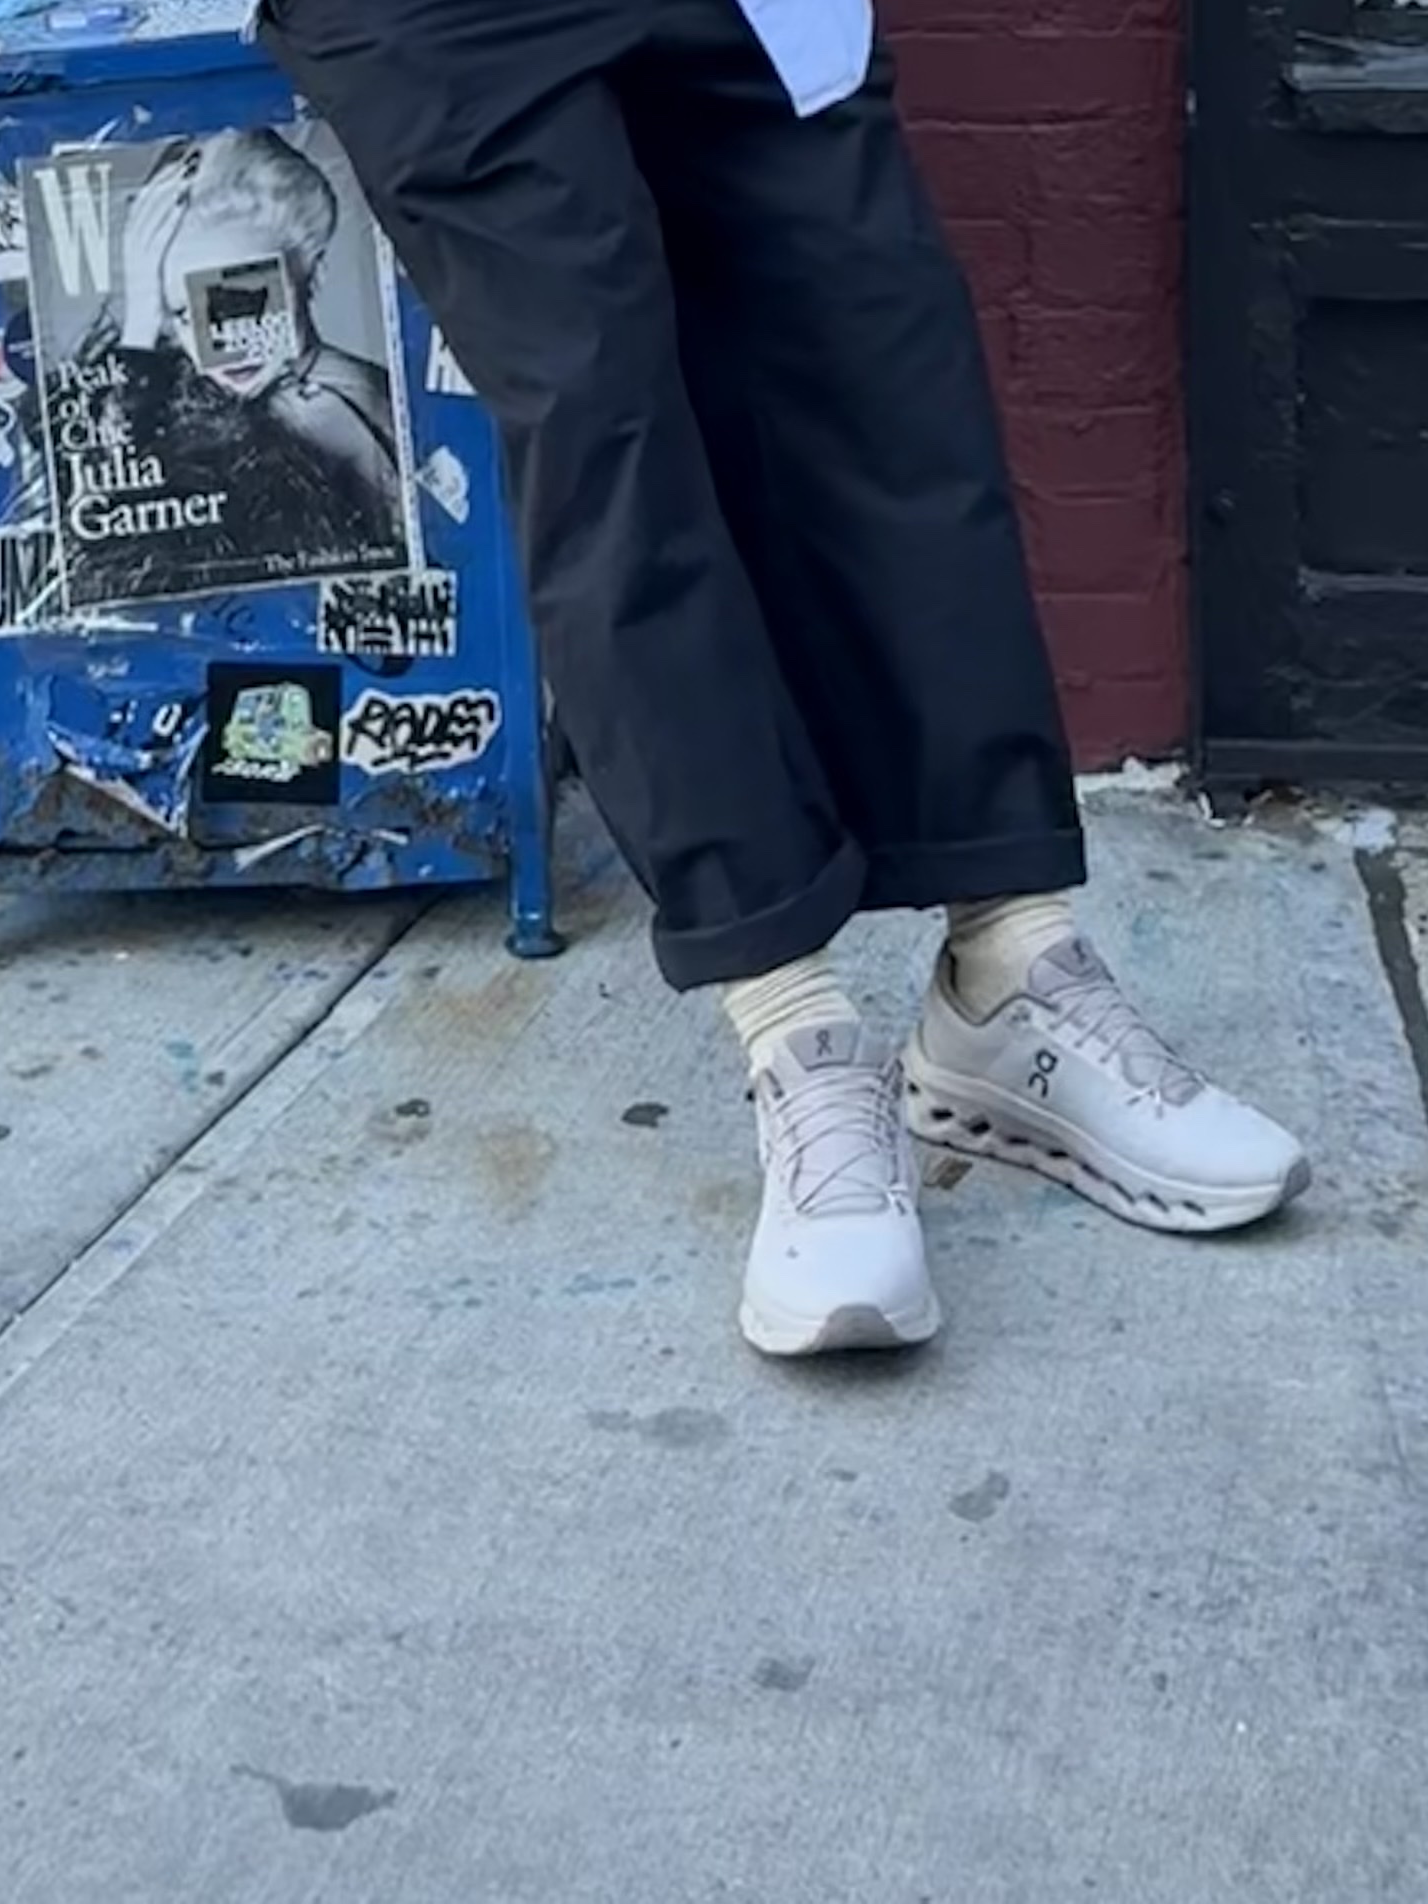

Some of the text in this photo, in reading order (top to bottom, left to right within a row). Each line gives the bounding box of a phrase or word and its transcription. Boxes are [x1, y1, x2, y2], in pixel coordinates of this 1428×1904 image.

[33, 163, 112, 296] W
[58, 353, 129, 393] Peak
[62, 443, 166, 504] Julia
[70, 490, 228, 541] Garner
